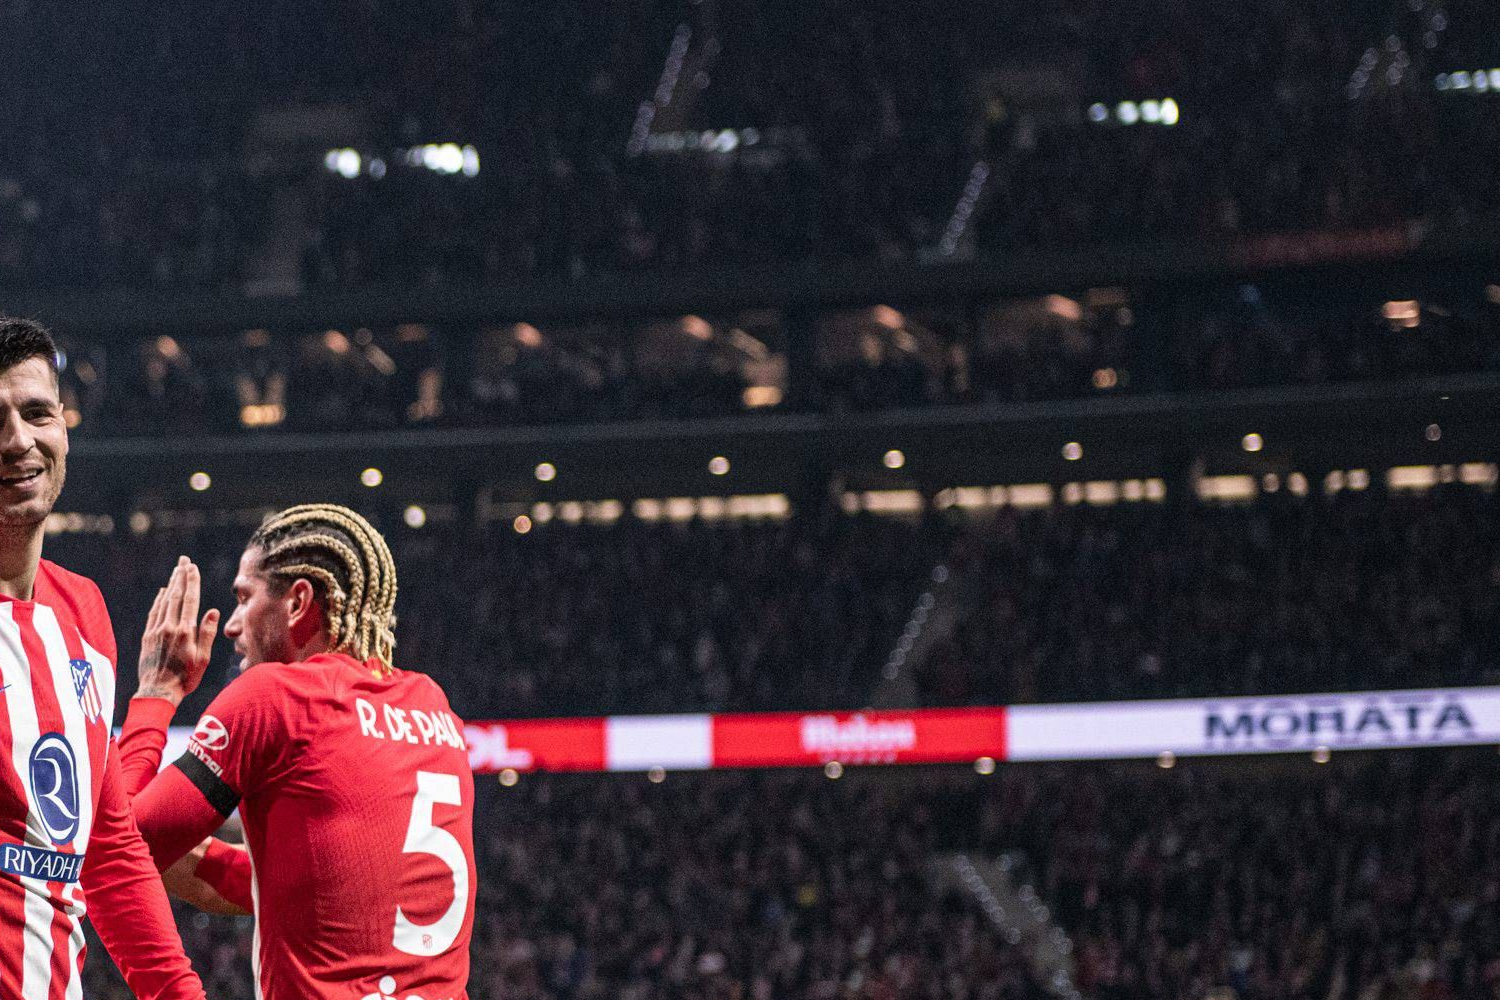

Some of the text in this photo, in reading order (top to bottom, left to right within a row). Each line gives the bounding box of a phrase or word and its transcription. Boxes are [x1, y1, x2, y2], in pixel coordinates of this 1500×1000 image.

[356, 697, 384, 739] R.
[383, 703, 419, 744] DE
[1205, 704, 1472, 738] MORATA
[4, 846, 76, 880] RIYADH
[392, 770, 469, 957] 5
